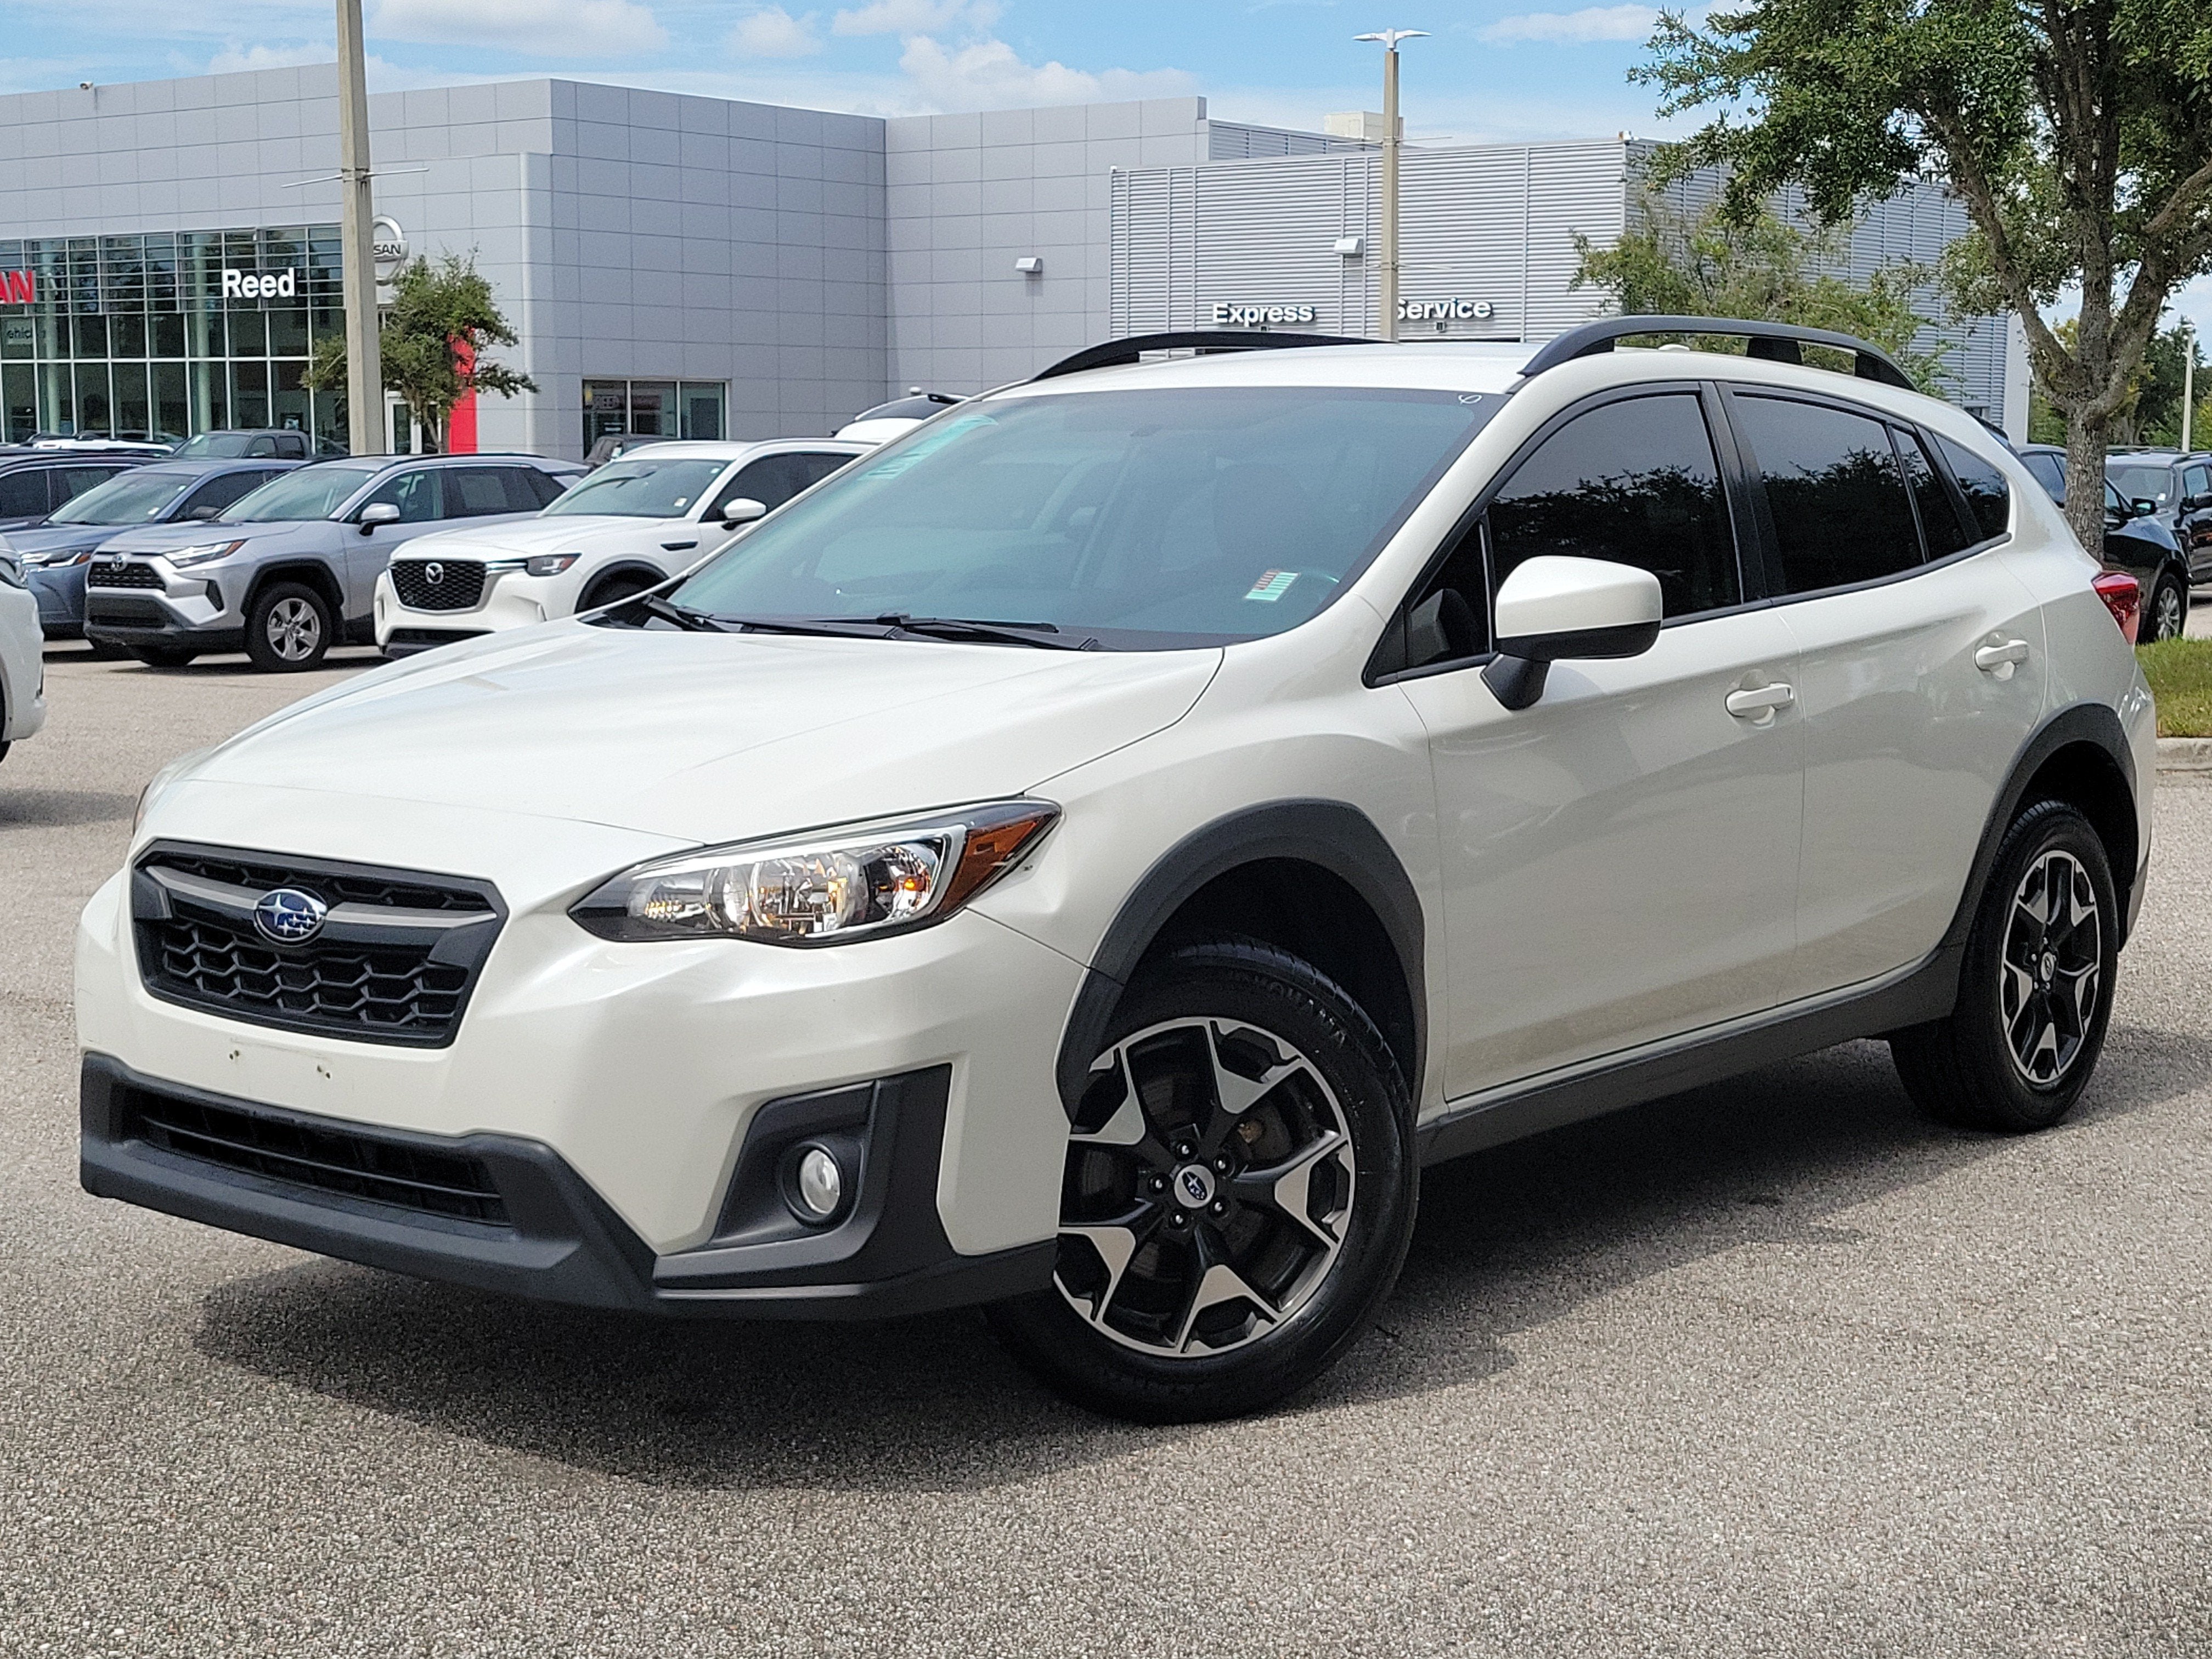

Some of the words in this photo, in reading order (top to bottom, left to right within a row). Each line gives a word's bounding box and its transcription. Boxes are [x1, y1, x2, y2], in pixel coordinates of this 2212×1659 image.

[222, 267, 295, 298] Reed
[1212, 302, 1314, 327] Express
[1398, 297, 1492, 320] Service
